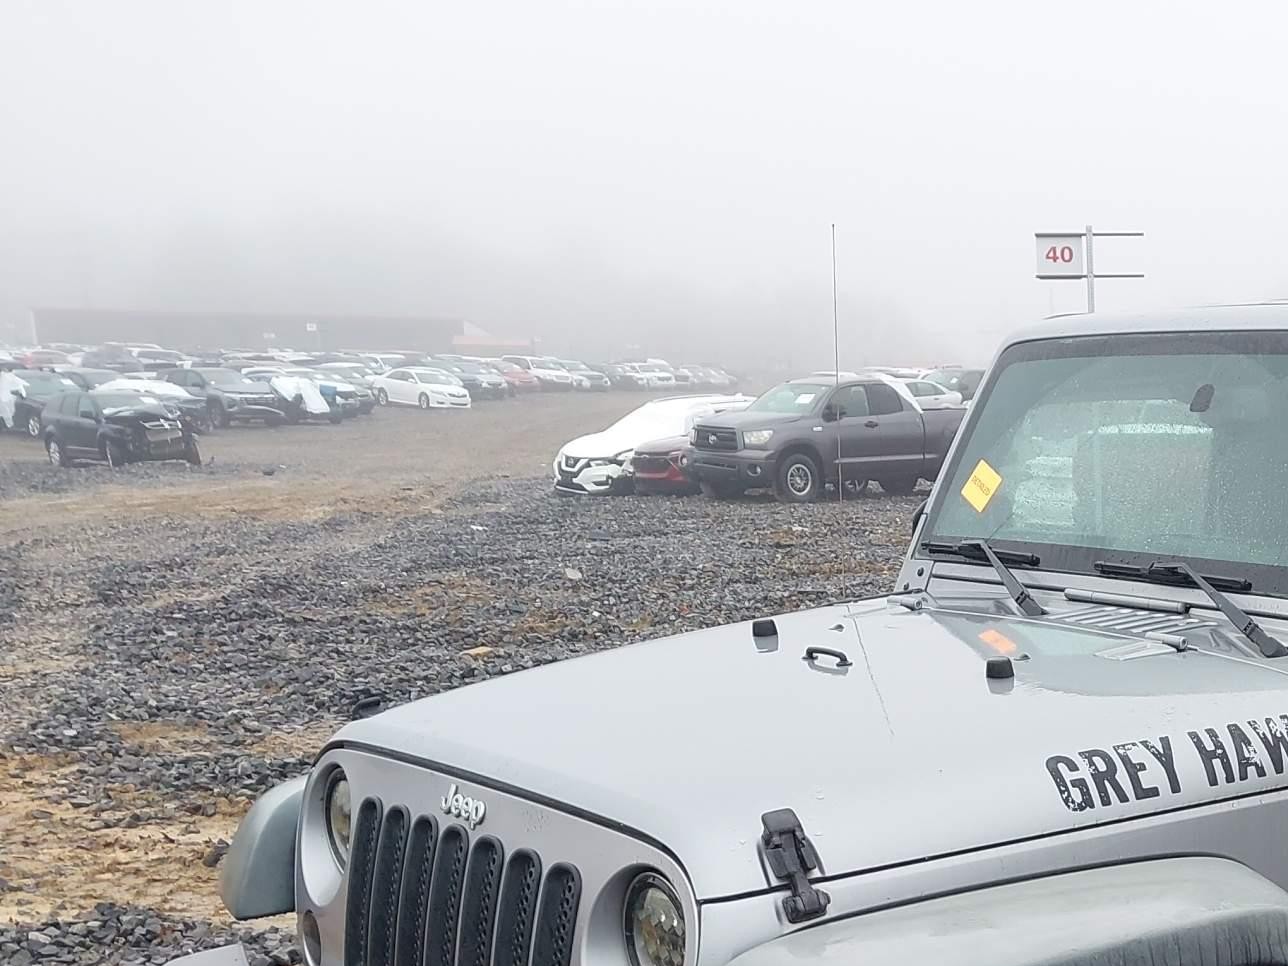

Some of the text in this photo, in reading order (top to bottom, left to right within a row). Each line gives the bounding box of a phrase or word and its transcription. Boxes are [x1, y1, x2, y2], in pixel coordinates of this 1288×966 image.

[1045, 245, 1074, 264] 40
[1045, 735, 1182, 813] GREY
[440, 783, 487, 831] Jeep
